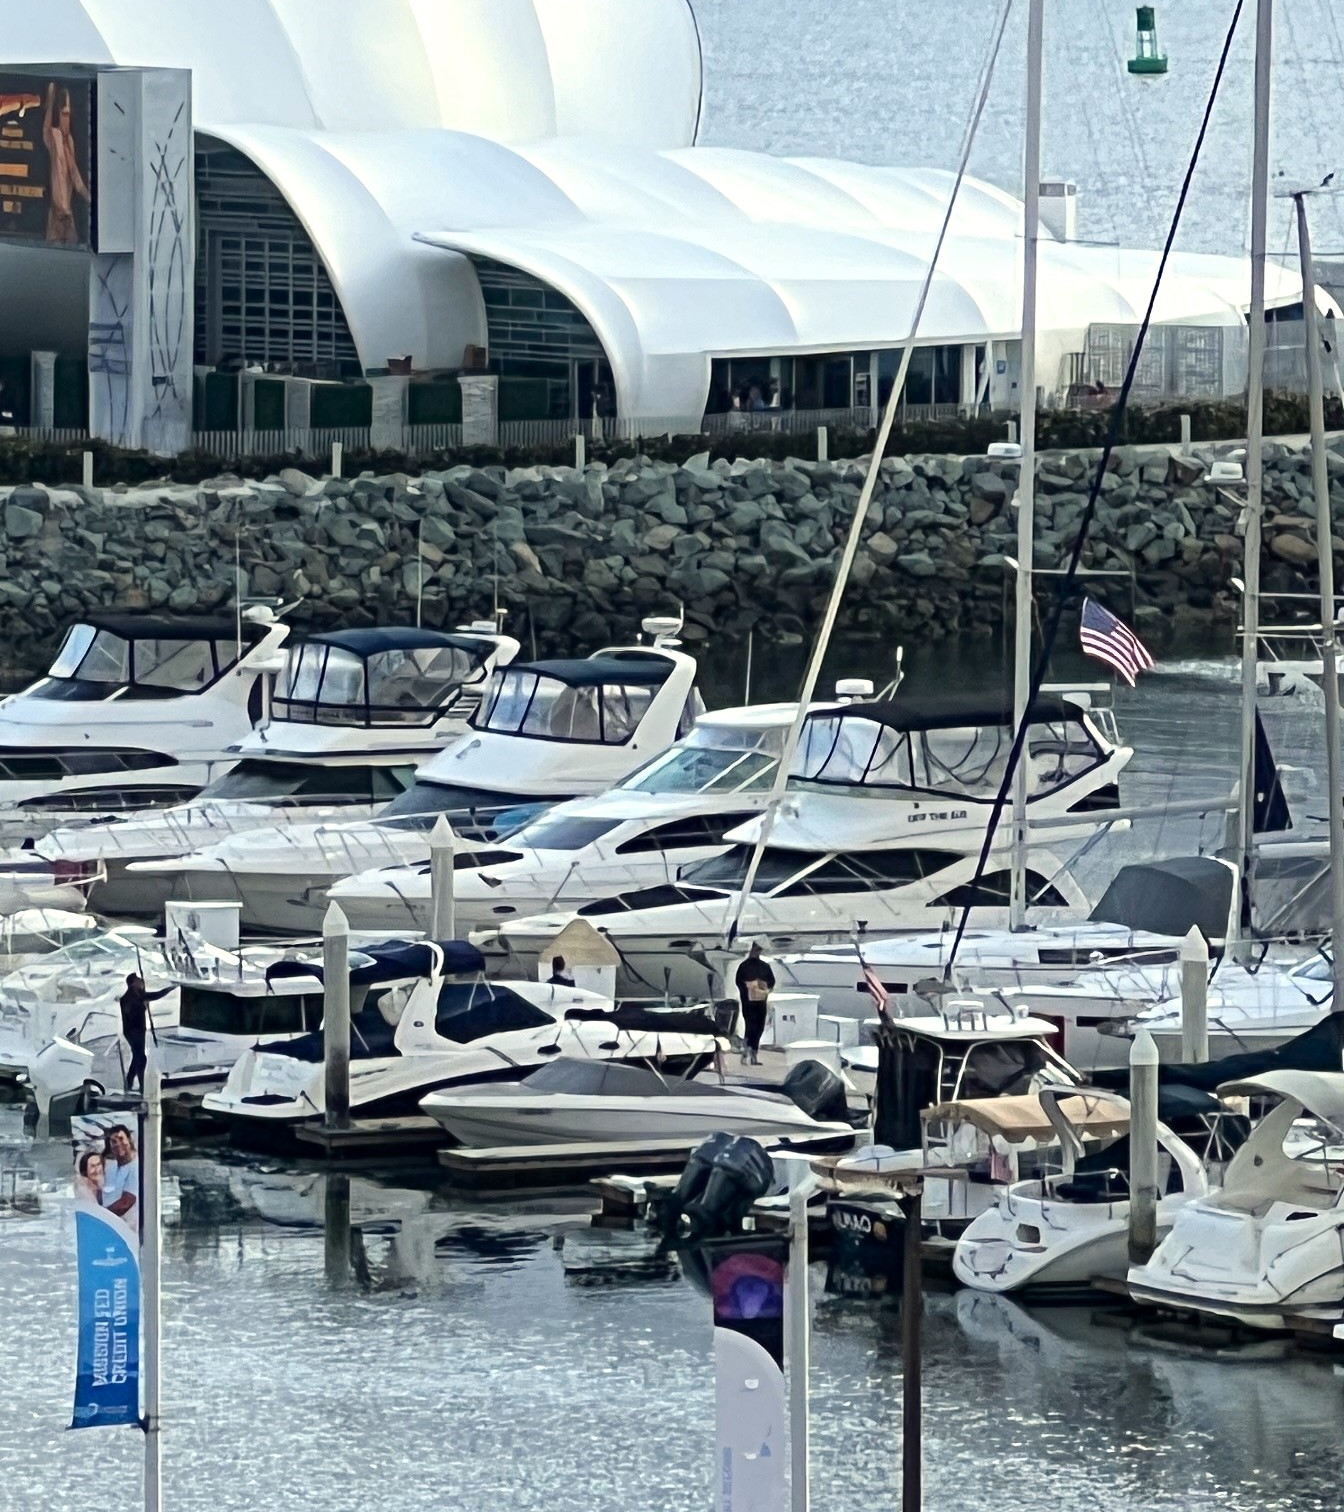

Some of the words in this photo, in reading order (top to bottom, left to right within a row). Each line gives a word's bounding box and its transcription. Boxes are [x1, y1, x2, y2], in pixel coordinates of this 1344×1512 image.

[94, 1288, 111, 1318] FED
[112, 1278, 128, 1326] UNION
[111, 1331, 127, 1384] CREDIT
